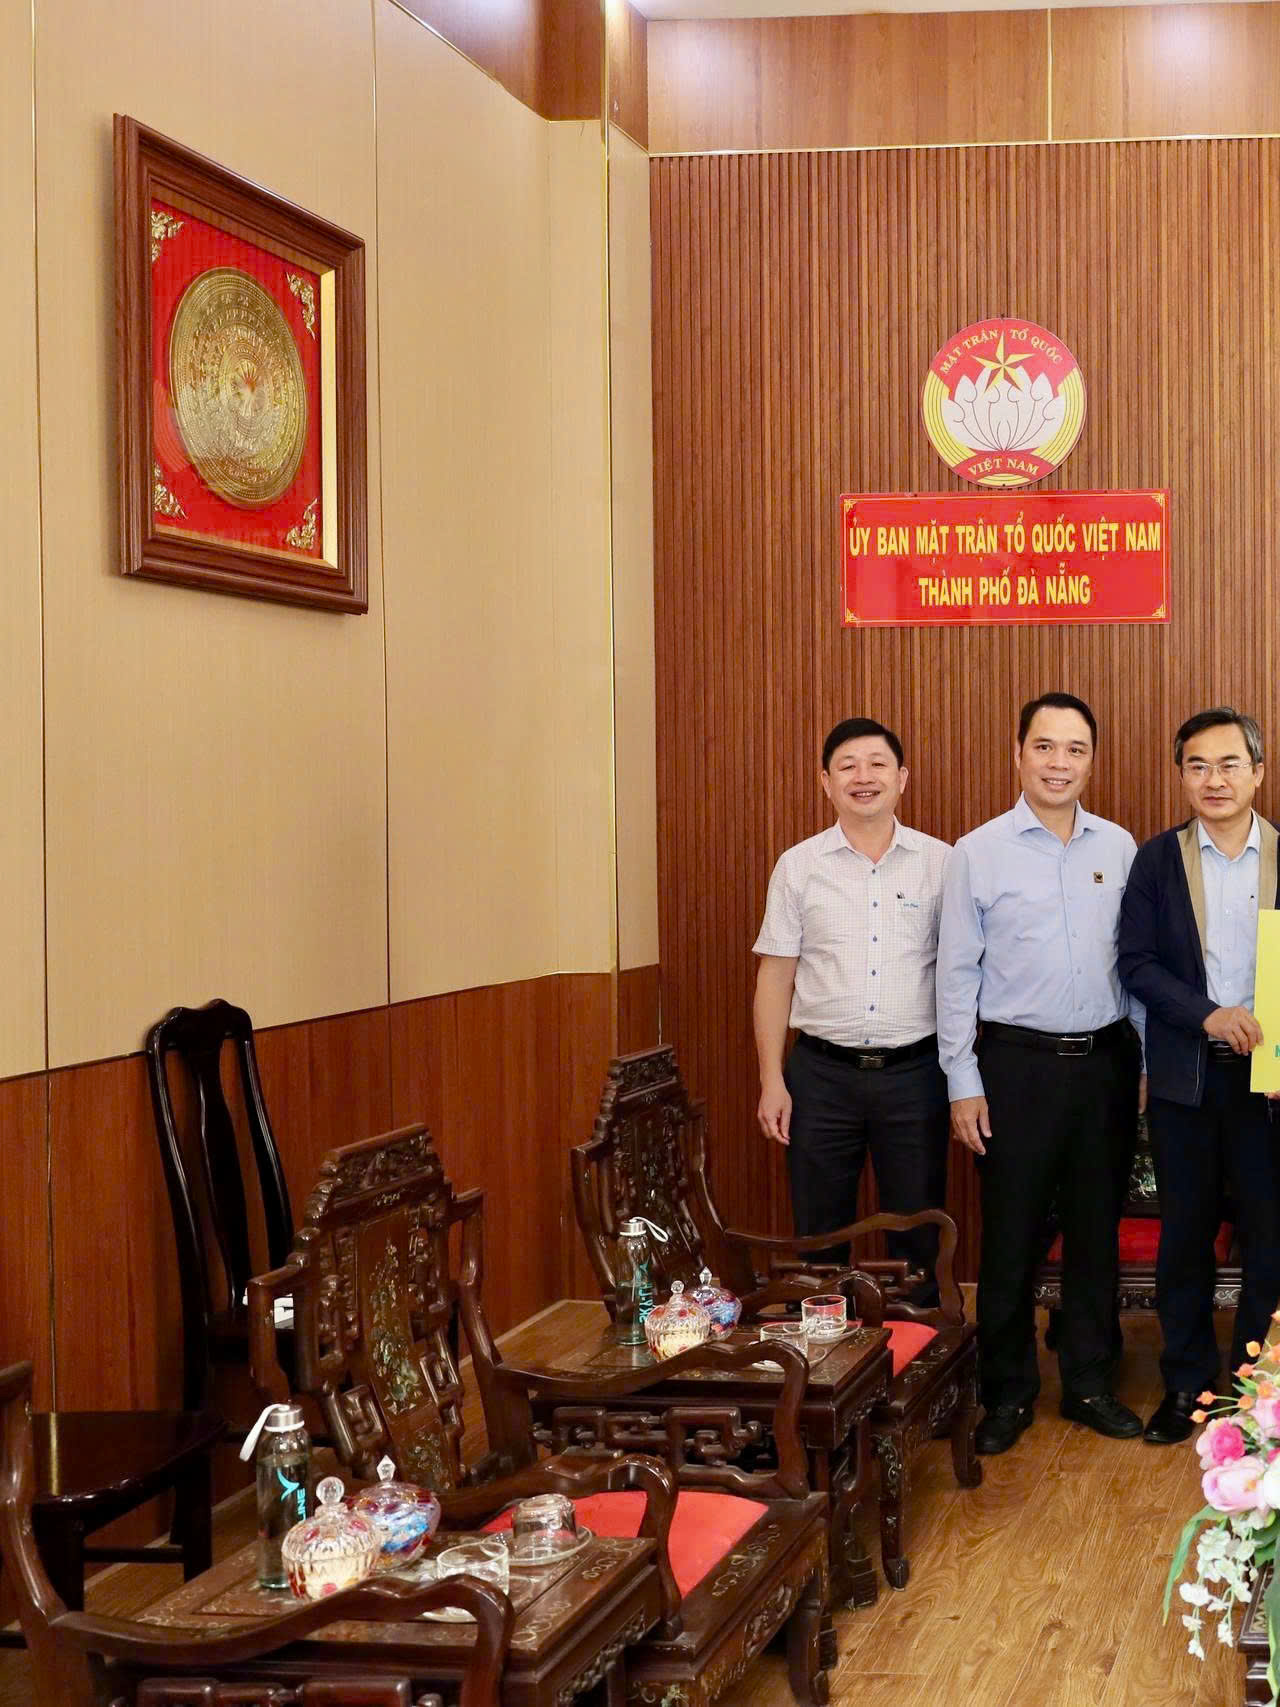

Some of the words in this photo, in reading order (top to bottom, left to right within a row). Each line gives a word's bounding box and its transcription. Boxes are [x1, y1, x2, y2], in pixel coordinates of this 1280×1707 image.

[968, 458, 1002, 475] VIỆT
[1008, 459, 1039, 475] NAM
[849, 517, 870, 556] ỦY
[878, 527, 909, 556] BAN
[916, 520, 949, 563] MẶT
[955, 519, 997, 562] TRẬN
[1003, 512, 1025, 554] TỔ
[1032, 514, 1076, 556] QUỐC
[1082, 516, 1119, 560] VIỆT
[1126, 522, 1160, 552] NAM
[918, 570, 973, 606] THÀNH
[979, 566, 1011, 606] PHỐ
[1017, 568, 1039, 605] ĐÀ
[1046, 562, 1090, 605] NẴNG
